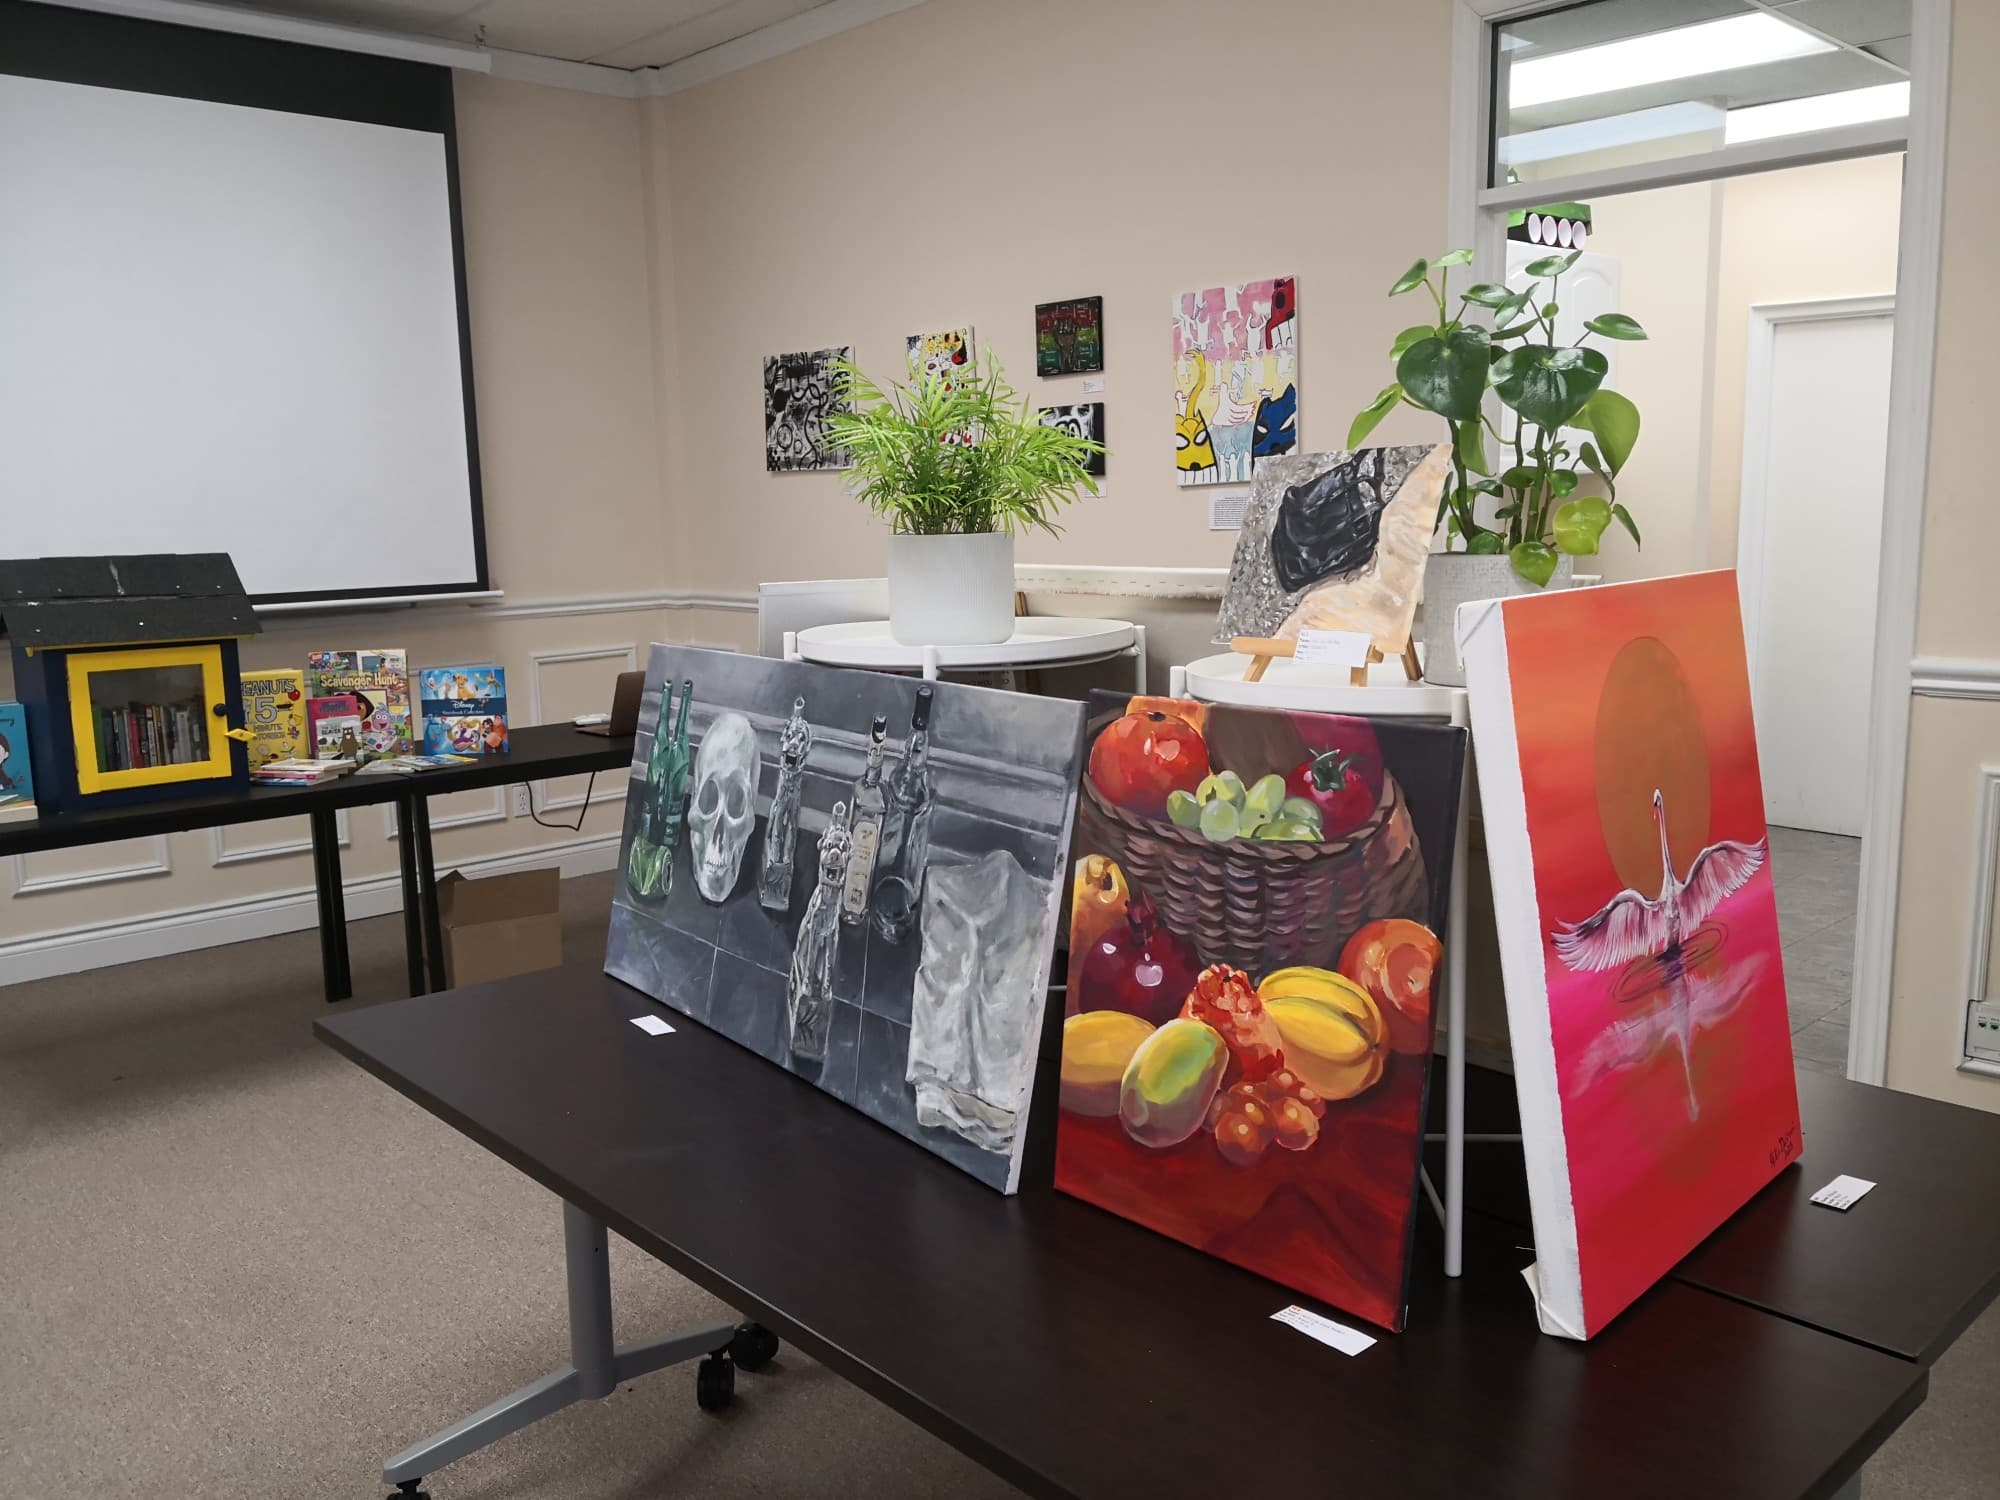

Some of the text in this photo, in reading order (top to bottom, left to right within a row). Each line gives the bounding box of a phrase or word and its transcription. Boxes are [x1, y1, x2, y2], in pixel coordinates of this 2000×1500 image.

[241, 679, 297, 697] EANUTS
[320, 672, 398, 690] Scavenger Hunt
[450, 700, 475, 711] Disney
